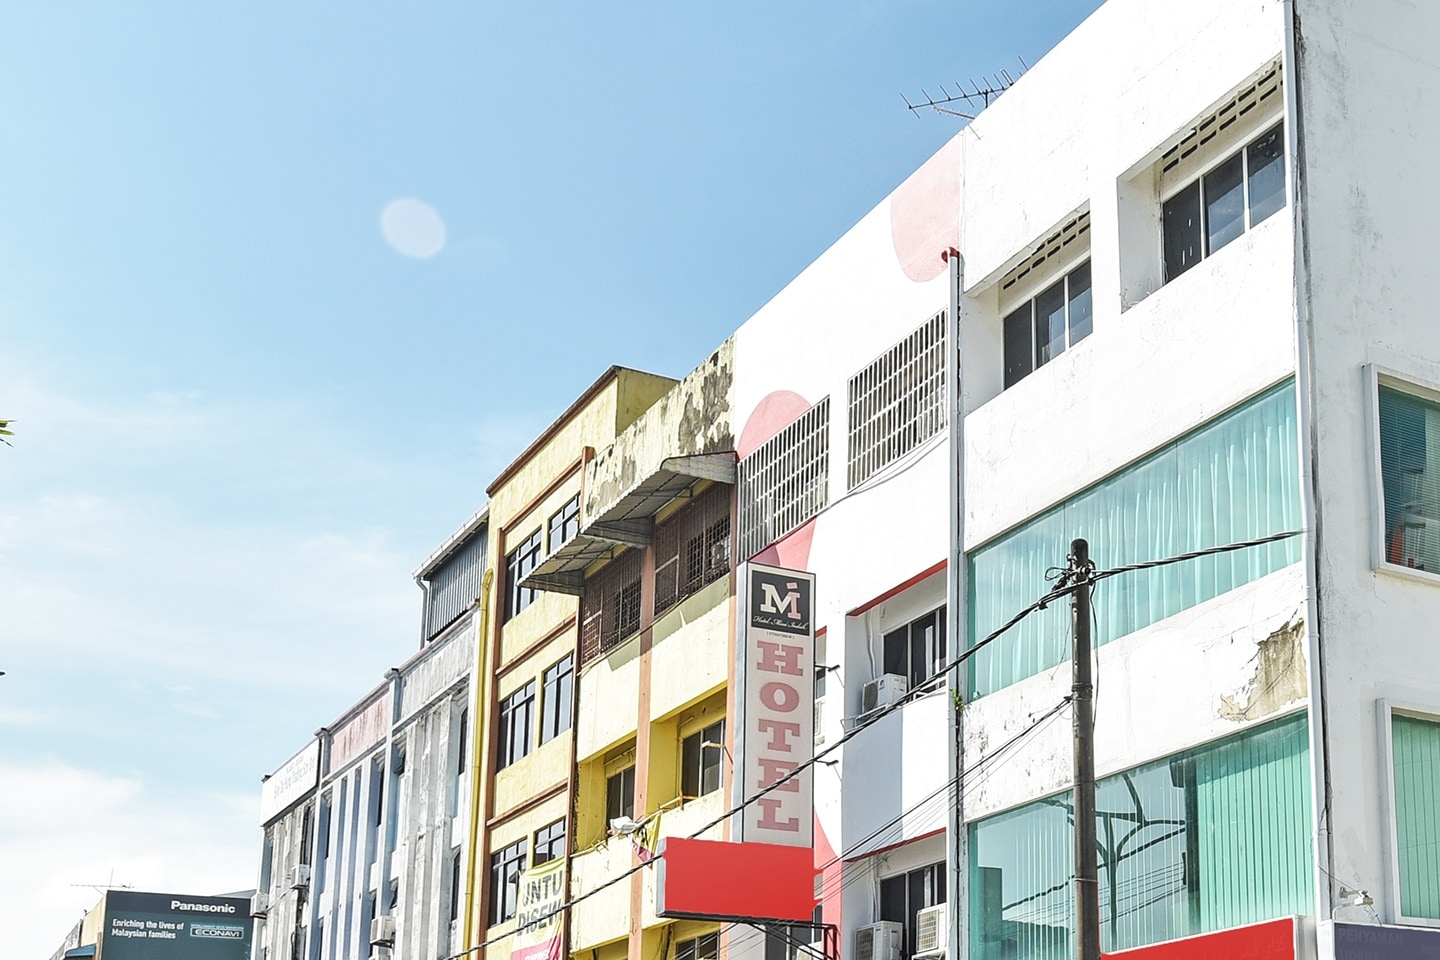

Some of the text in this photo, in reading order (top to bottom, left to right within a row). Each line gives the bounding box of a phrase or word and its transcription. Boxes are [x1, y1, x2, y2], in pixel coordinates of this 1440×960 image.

[757, 640, 804, 832] HOTEL
[523, 870, 563, 906] UNTU
[170, 900, 236, 914] Panasonic
[517, 898, 563, 936] DISEW
[111, 928, 176, 939] Malaysian families
[112, 918, 145, 929] Enriching
[145, 920, 157, 929] the
[158, 921, 175, 930] lives
[176, 922, 184, 930] of
